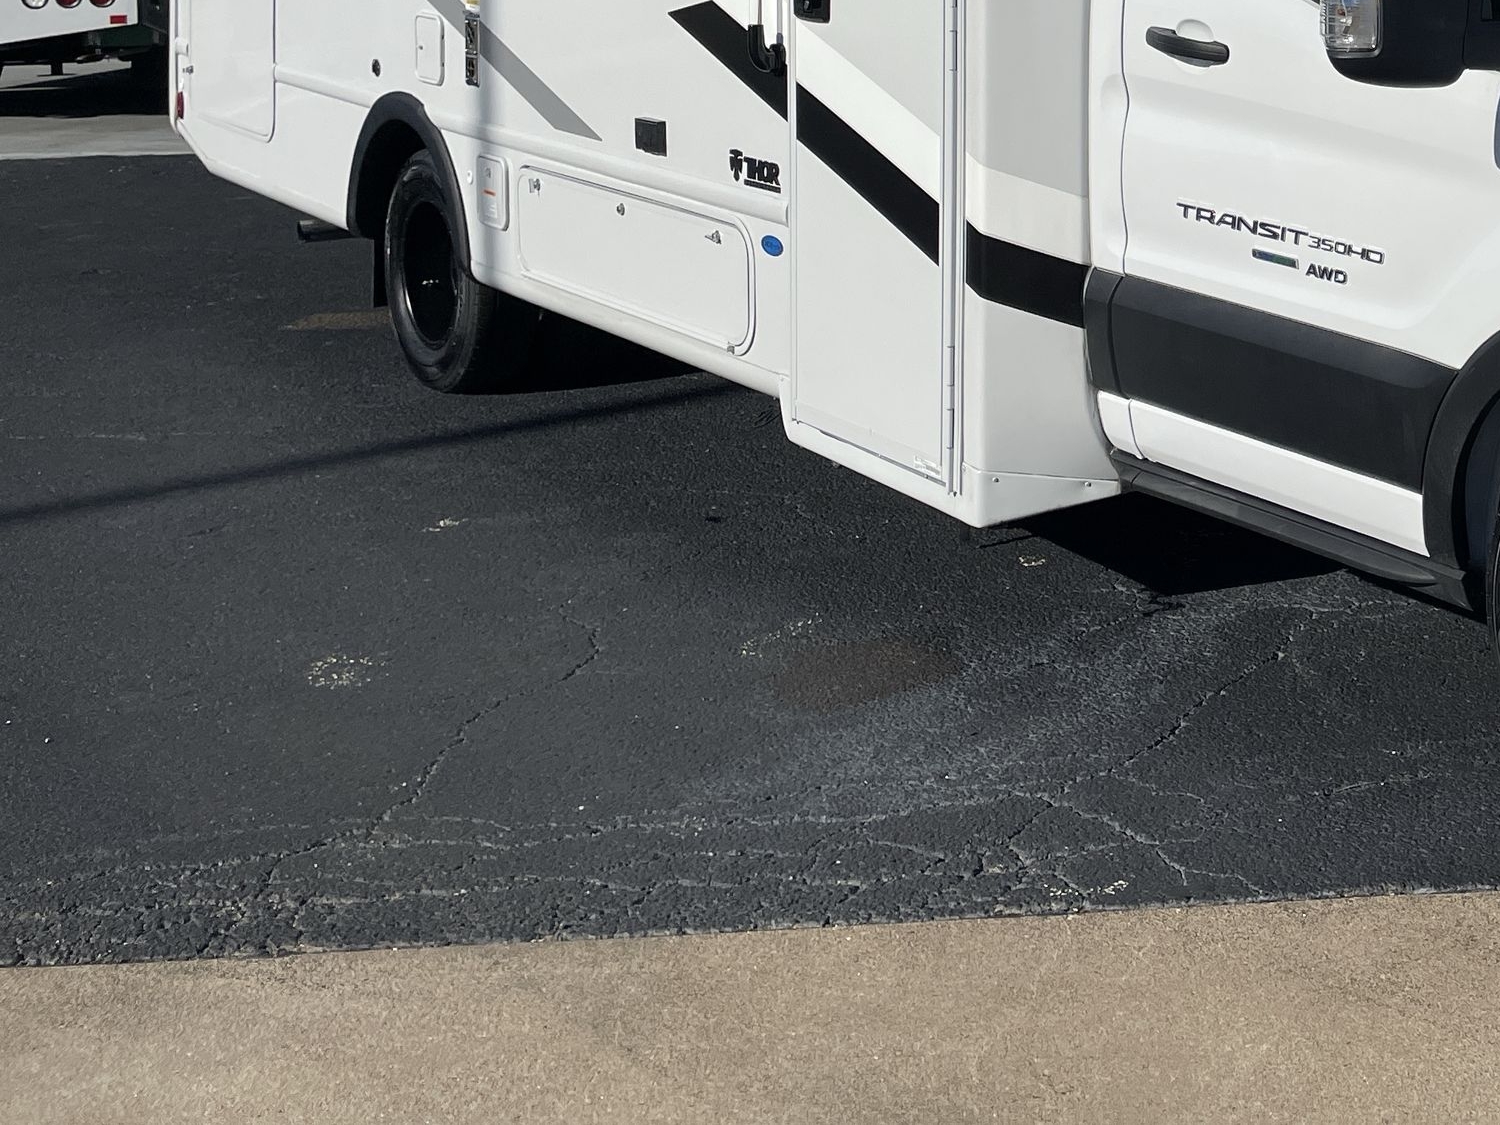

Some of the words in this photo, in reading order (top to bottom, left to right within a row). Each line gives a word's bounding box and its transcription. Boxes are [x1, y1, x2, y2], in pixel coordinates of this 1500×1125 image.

[743, 156, 781, 186] THOR
[1176, 202, 1309, 246] TRANSIT
[1307, 235, 1385, 265] 350HD
[1305, 262, 1348, 285] AWD
